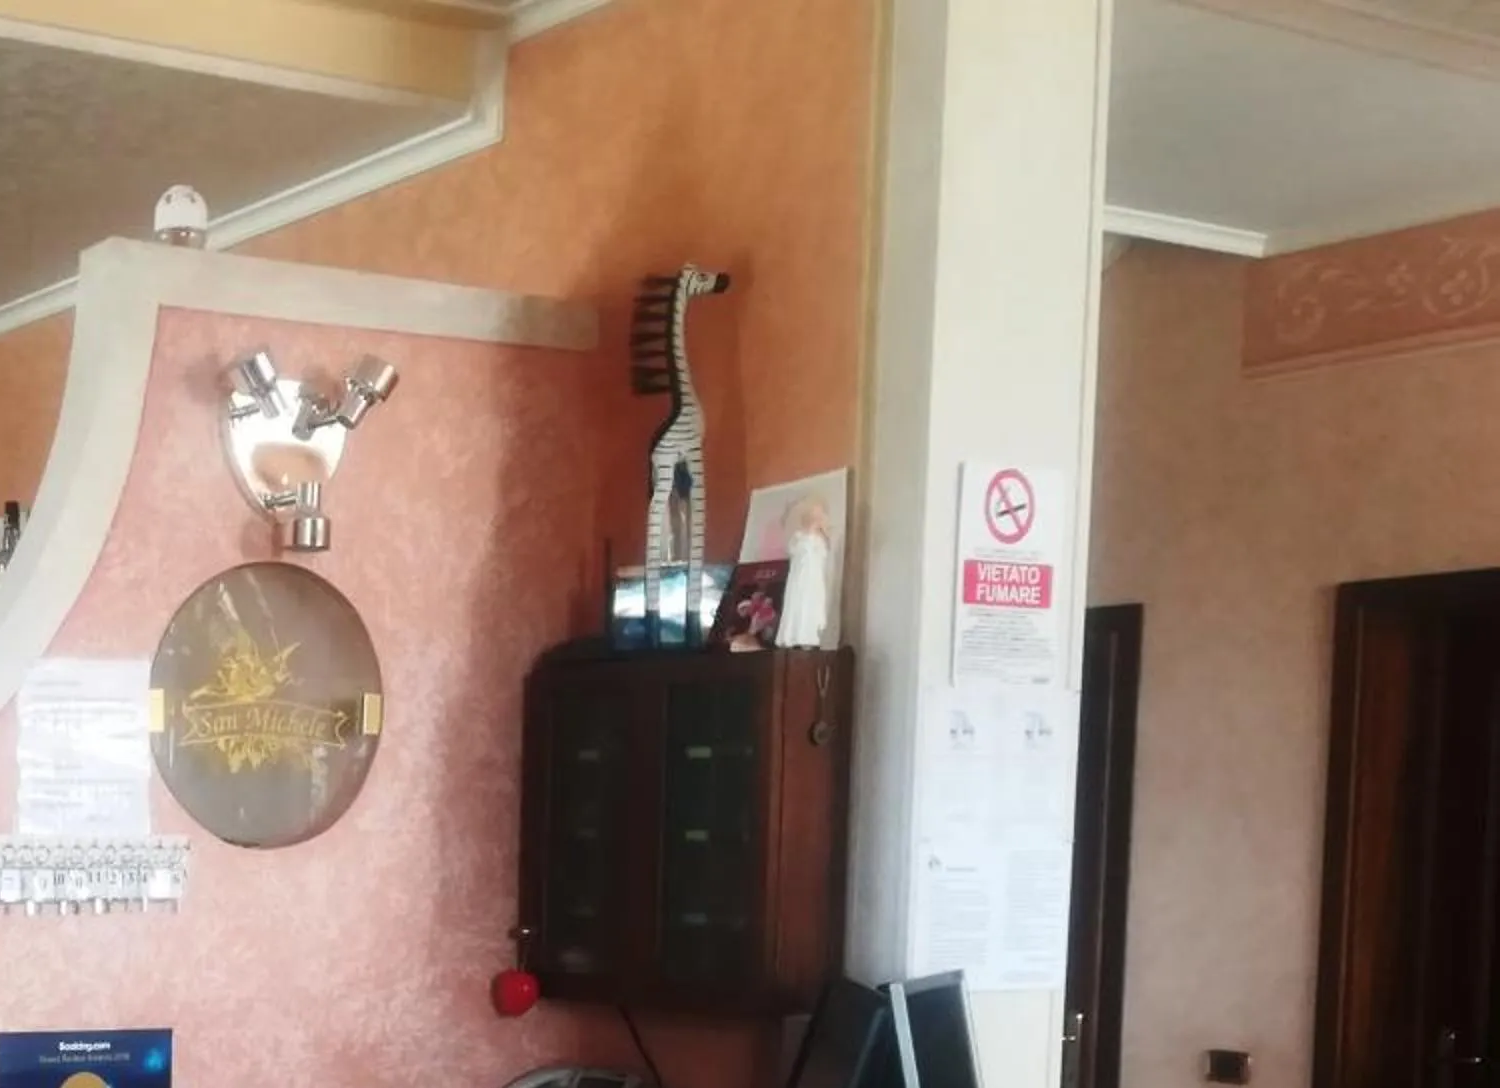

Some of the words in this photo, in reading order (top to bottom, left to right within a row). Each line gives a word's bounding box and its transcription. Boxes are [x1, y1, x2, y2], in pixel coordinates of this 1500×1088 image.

[977, 561, 1041, 585] VIETATO
[975, 583, 1042, 605] FUMARE
[59, 1041, 111, 1053] Booking.com
